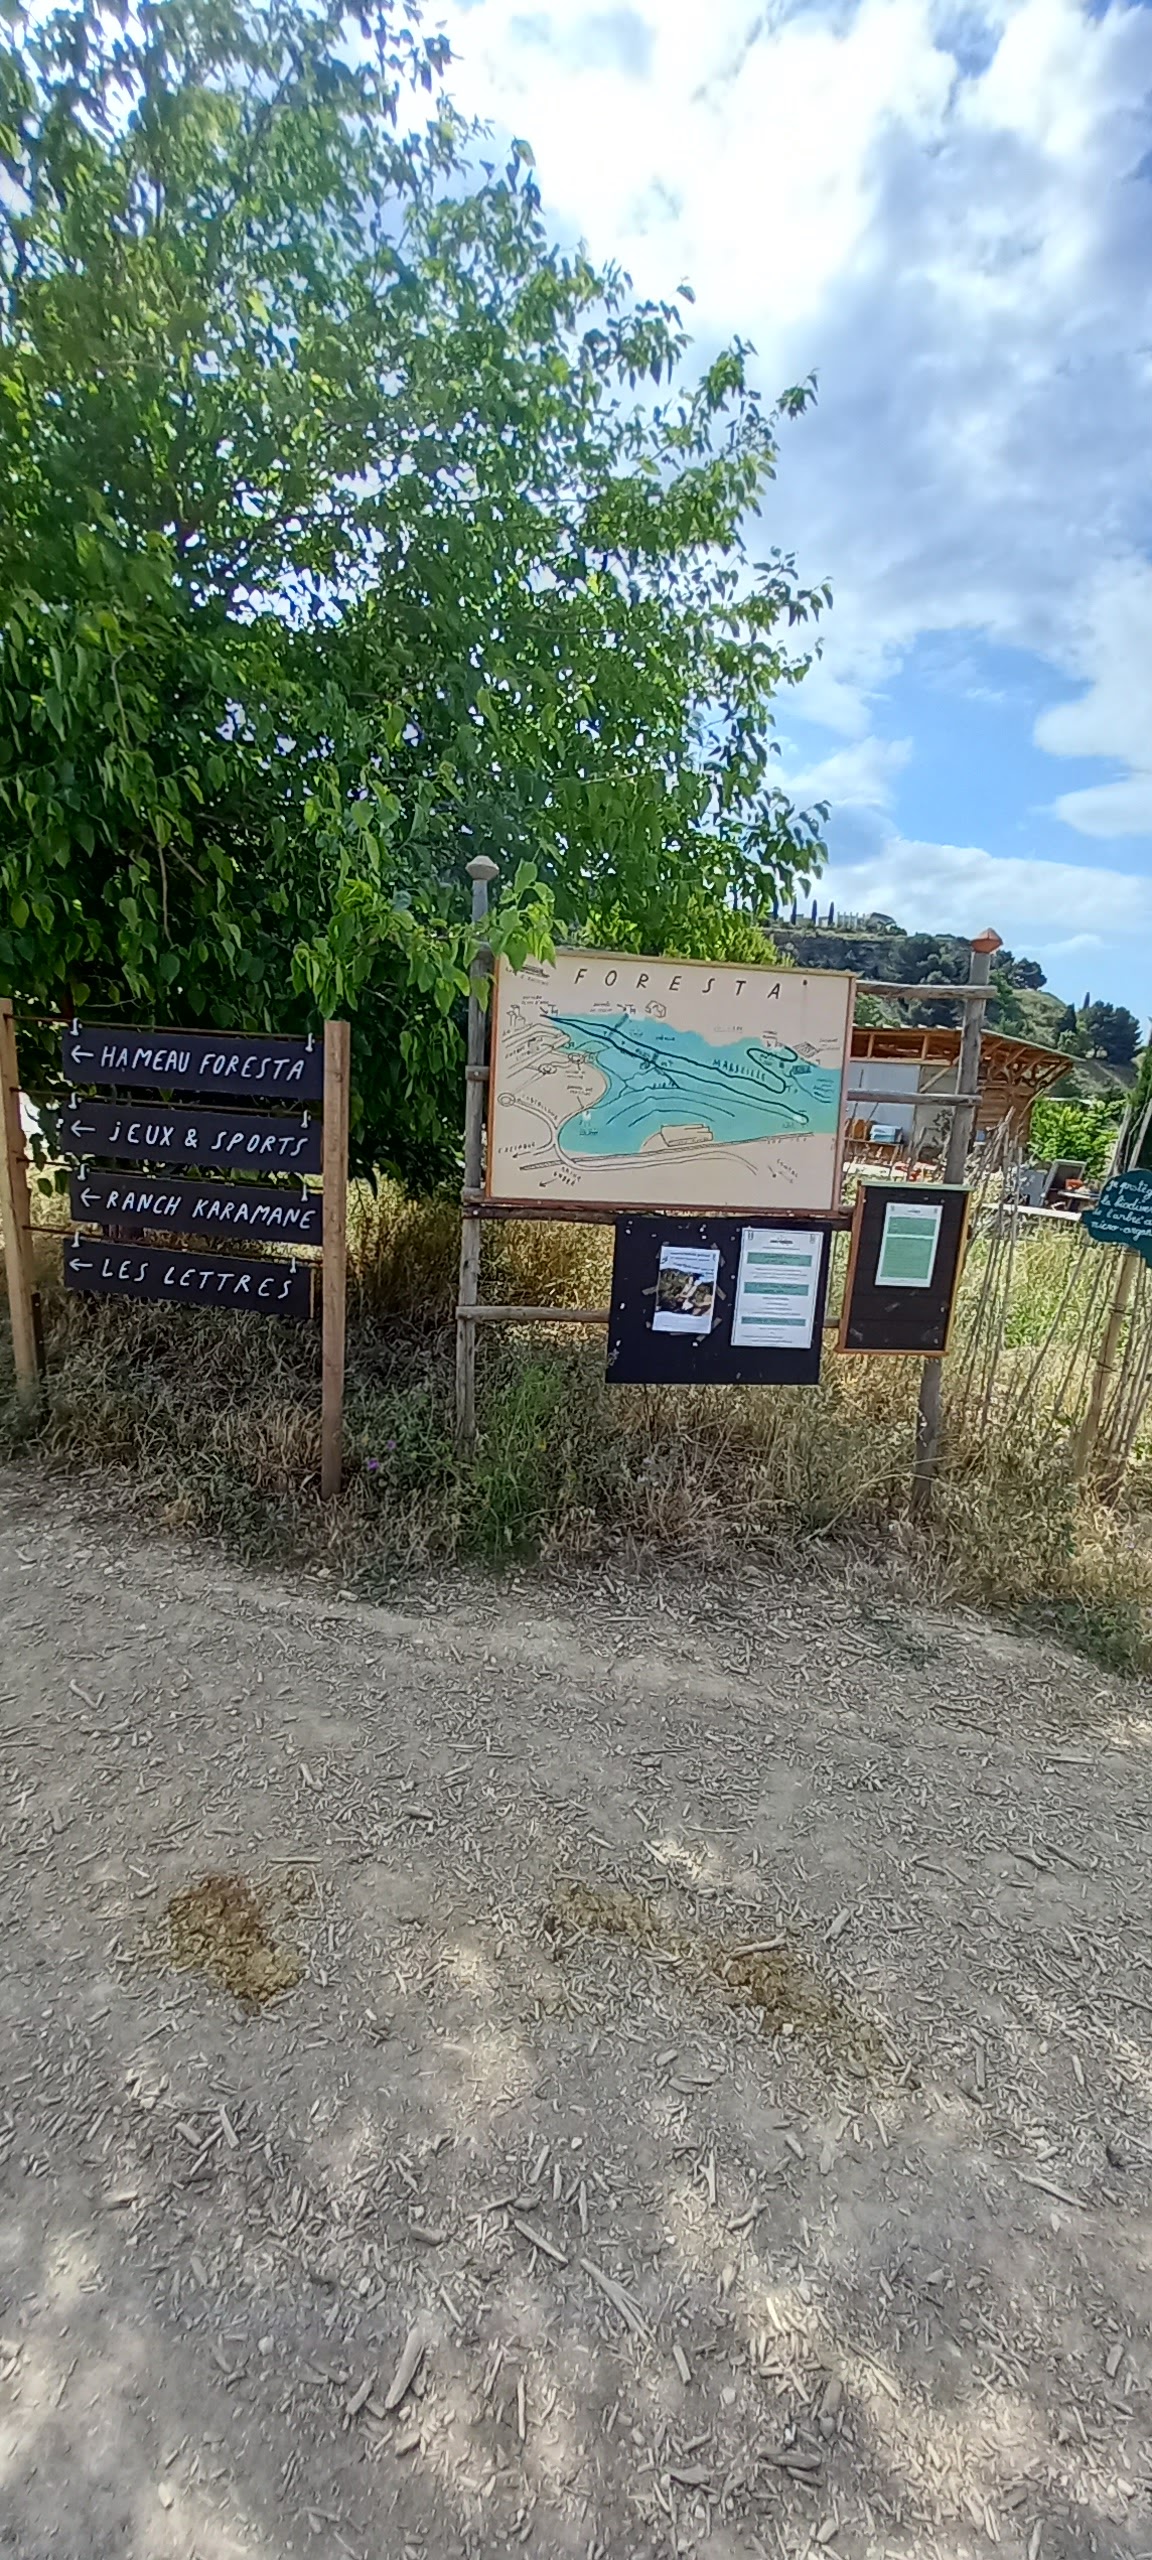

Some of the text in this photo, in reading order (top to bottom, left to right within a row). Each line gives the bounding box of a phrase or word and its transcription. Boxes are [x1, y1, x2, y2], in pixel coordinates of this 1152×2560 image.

[574, 968, 782, 1000] FORESTA
[100, 1045, 305, 1081] HAMEAU FORESTA
[184, 1129, 198, 1148] &
[211, 1130, 309, 1157] SPORTS
[1114, 1195, 1152, 1213] biodiver
[1119, 1180, 1152, 1200] protèg
[106, 1189, 316, 1230] RANCH KARAMANE
[1091, 1220, 1152, 1241] micro-organ
[101, 1257, 292, 1300] LES LETTRES
